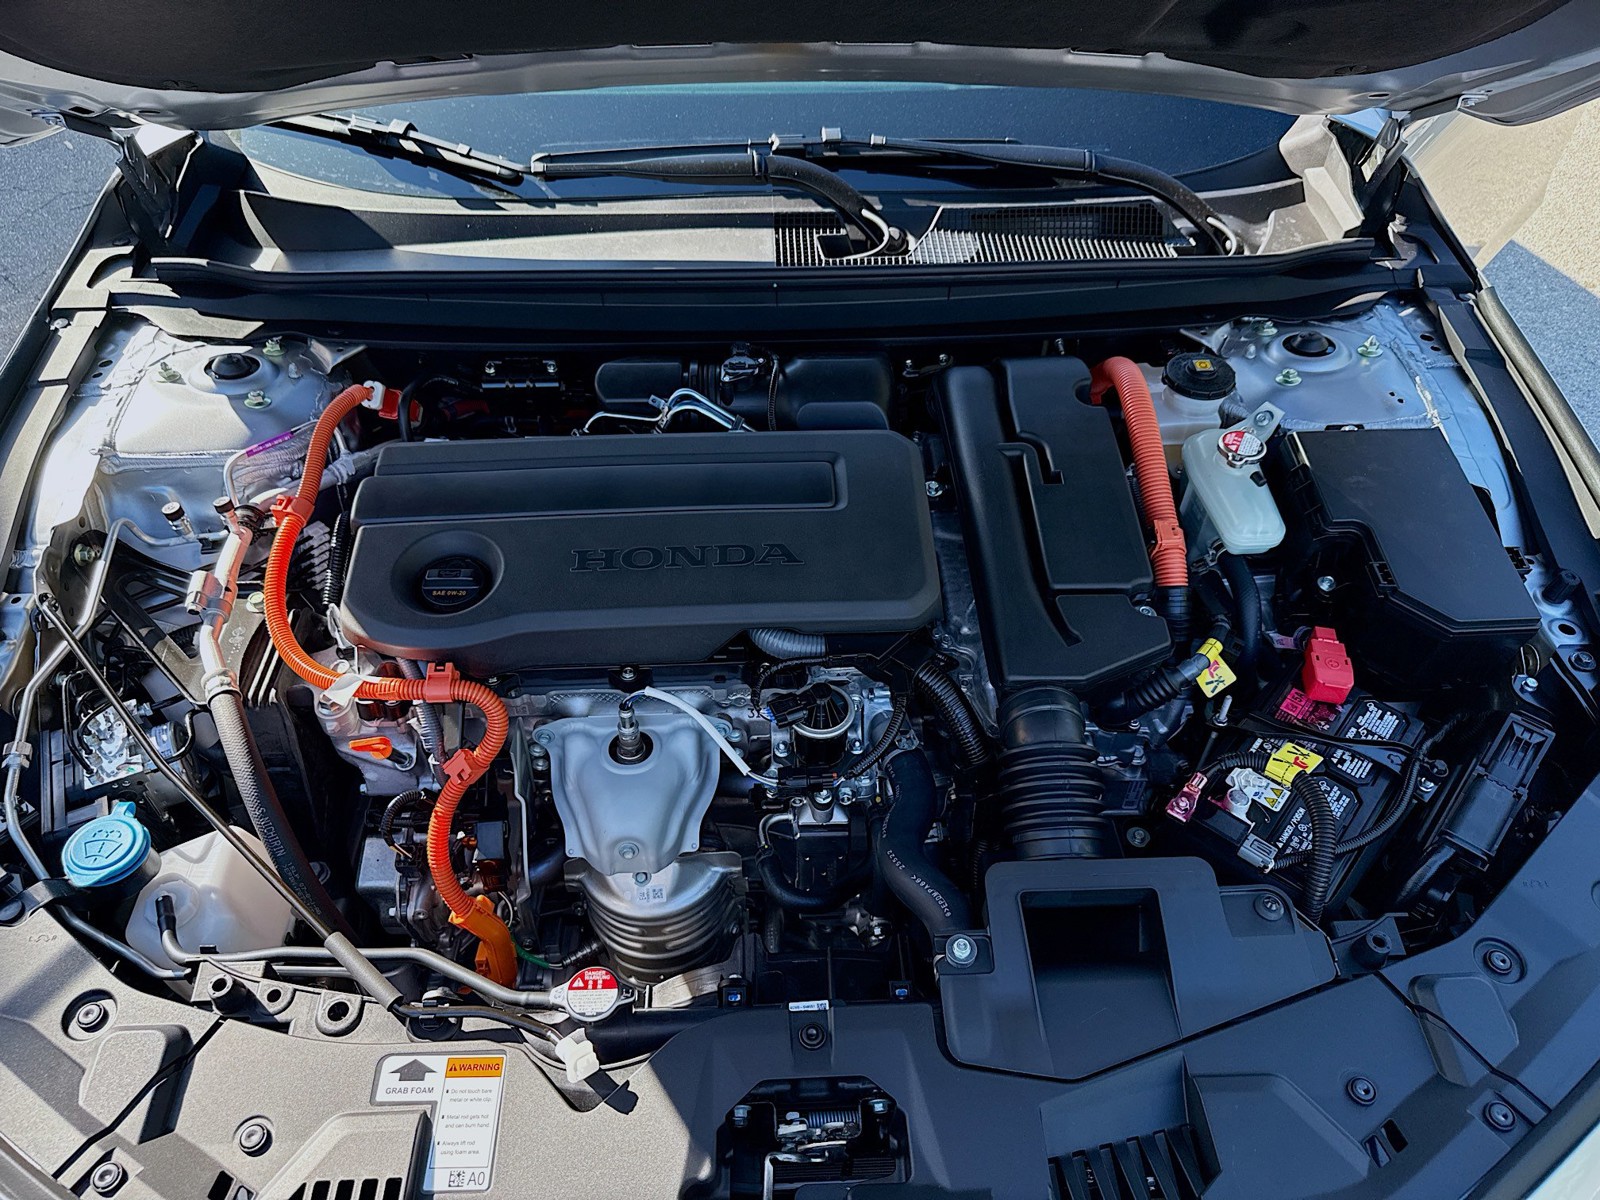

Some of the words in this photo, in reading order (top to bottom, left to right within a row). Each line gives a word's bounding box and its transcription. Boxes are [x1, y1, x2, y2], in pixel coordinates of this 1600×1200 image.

[570, 543, 805, 573] HONDA
[459, 1063, 500, 1071] WARNING
[385, 1087, 409, 1095] GRAB
[410, 1086, 434, 1094] FOAM
[466, 1171, 486, 1186] A0
